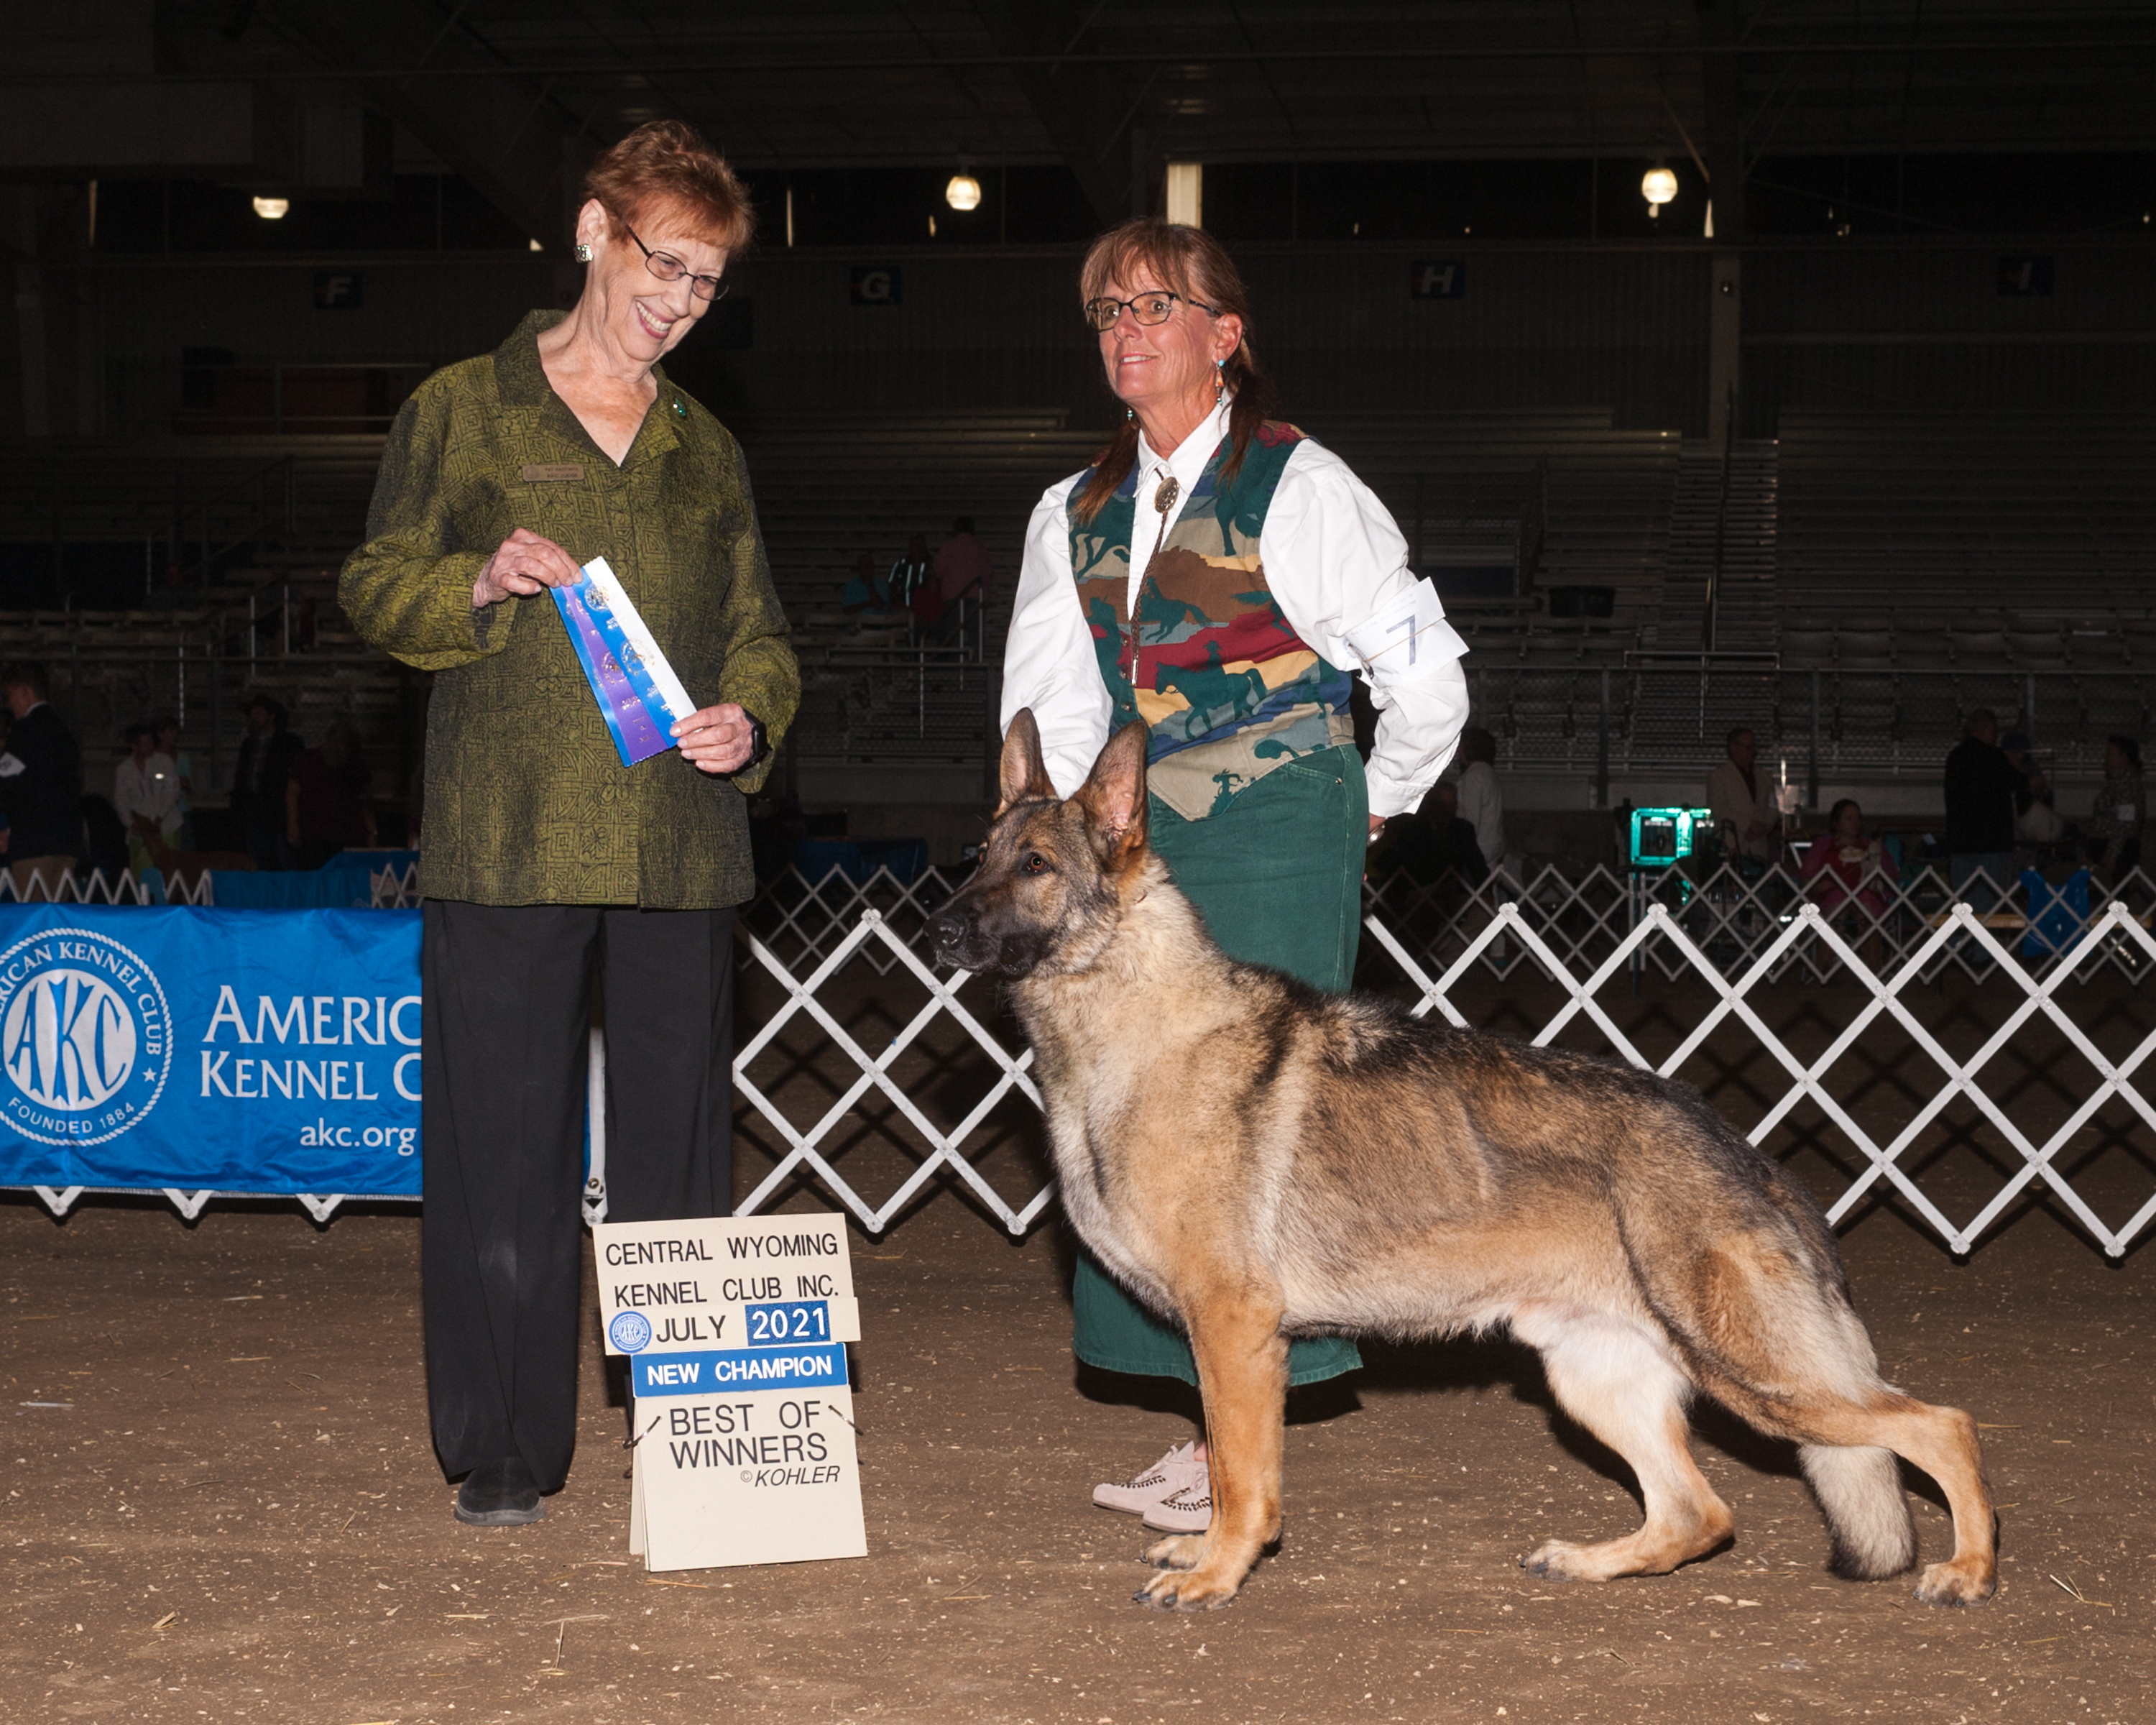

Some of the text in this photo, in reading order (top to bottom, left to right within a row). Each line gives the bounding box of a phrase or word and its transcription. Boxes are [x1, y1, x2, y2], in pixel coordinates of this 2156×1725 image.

[326, 277, 351, 304] F
[862, 272, 891, 299] G
[1422, 264, 1455, 294] H
[1385, 614, 1416, 666] 7
[0, 942, 162, 1055] RICAN KENNEL CLUB
[201, 985, 422, 1046] AMERIC
[9, 975, 126, 1106] AKC
[201, 1050, 379, 1100] KENNEL
[9, 1097, 134, 1133] FOUNDED 1884
[300, 1117, 417, 1156] akc.org
[606, 1233, 838, 1266] CENTRAL WYOMING
[614, 1274, 839, 1307] KENNEL CLUB INC.
[656, 1307, 826, 1342] JULY 2021
[647, 1355, 832, 1386] NEW CHAMPION
[670, 1400, 821, 1435] BEST OF
[669, 1432, 827, 1469] WINNERS
